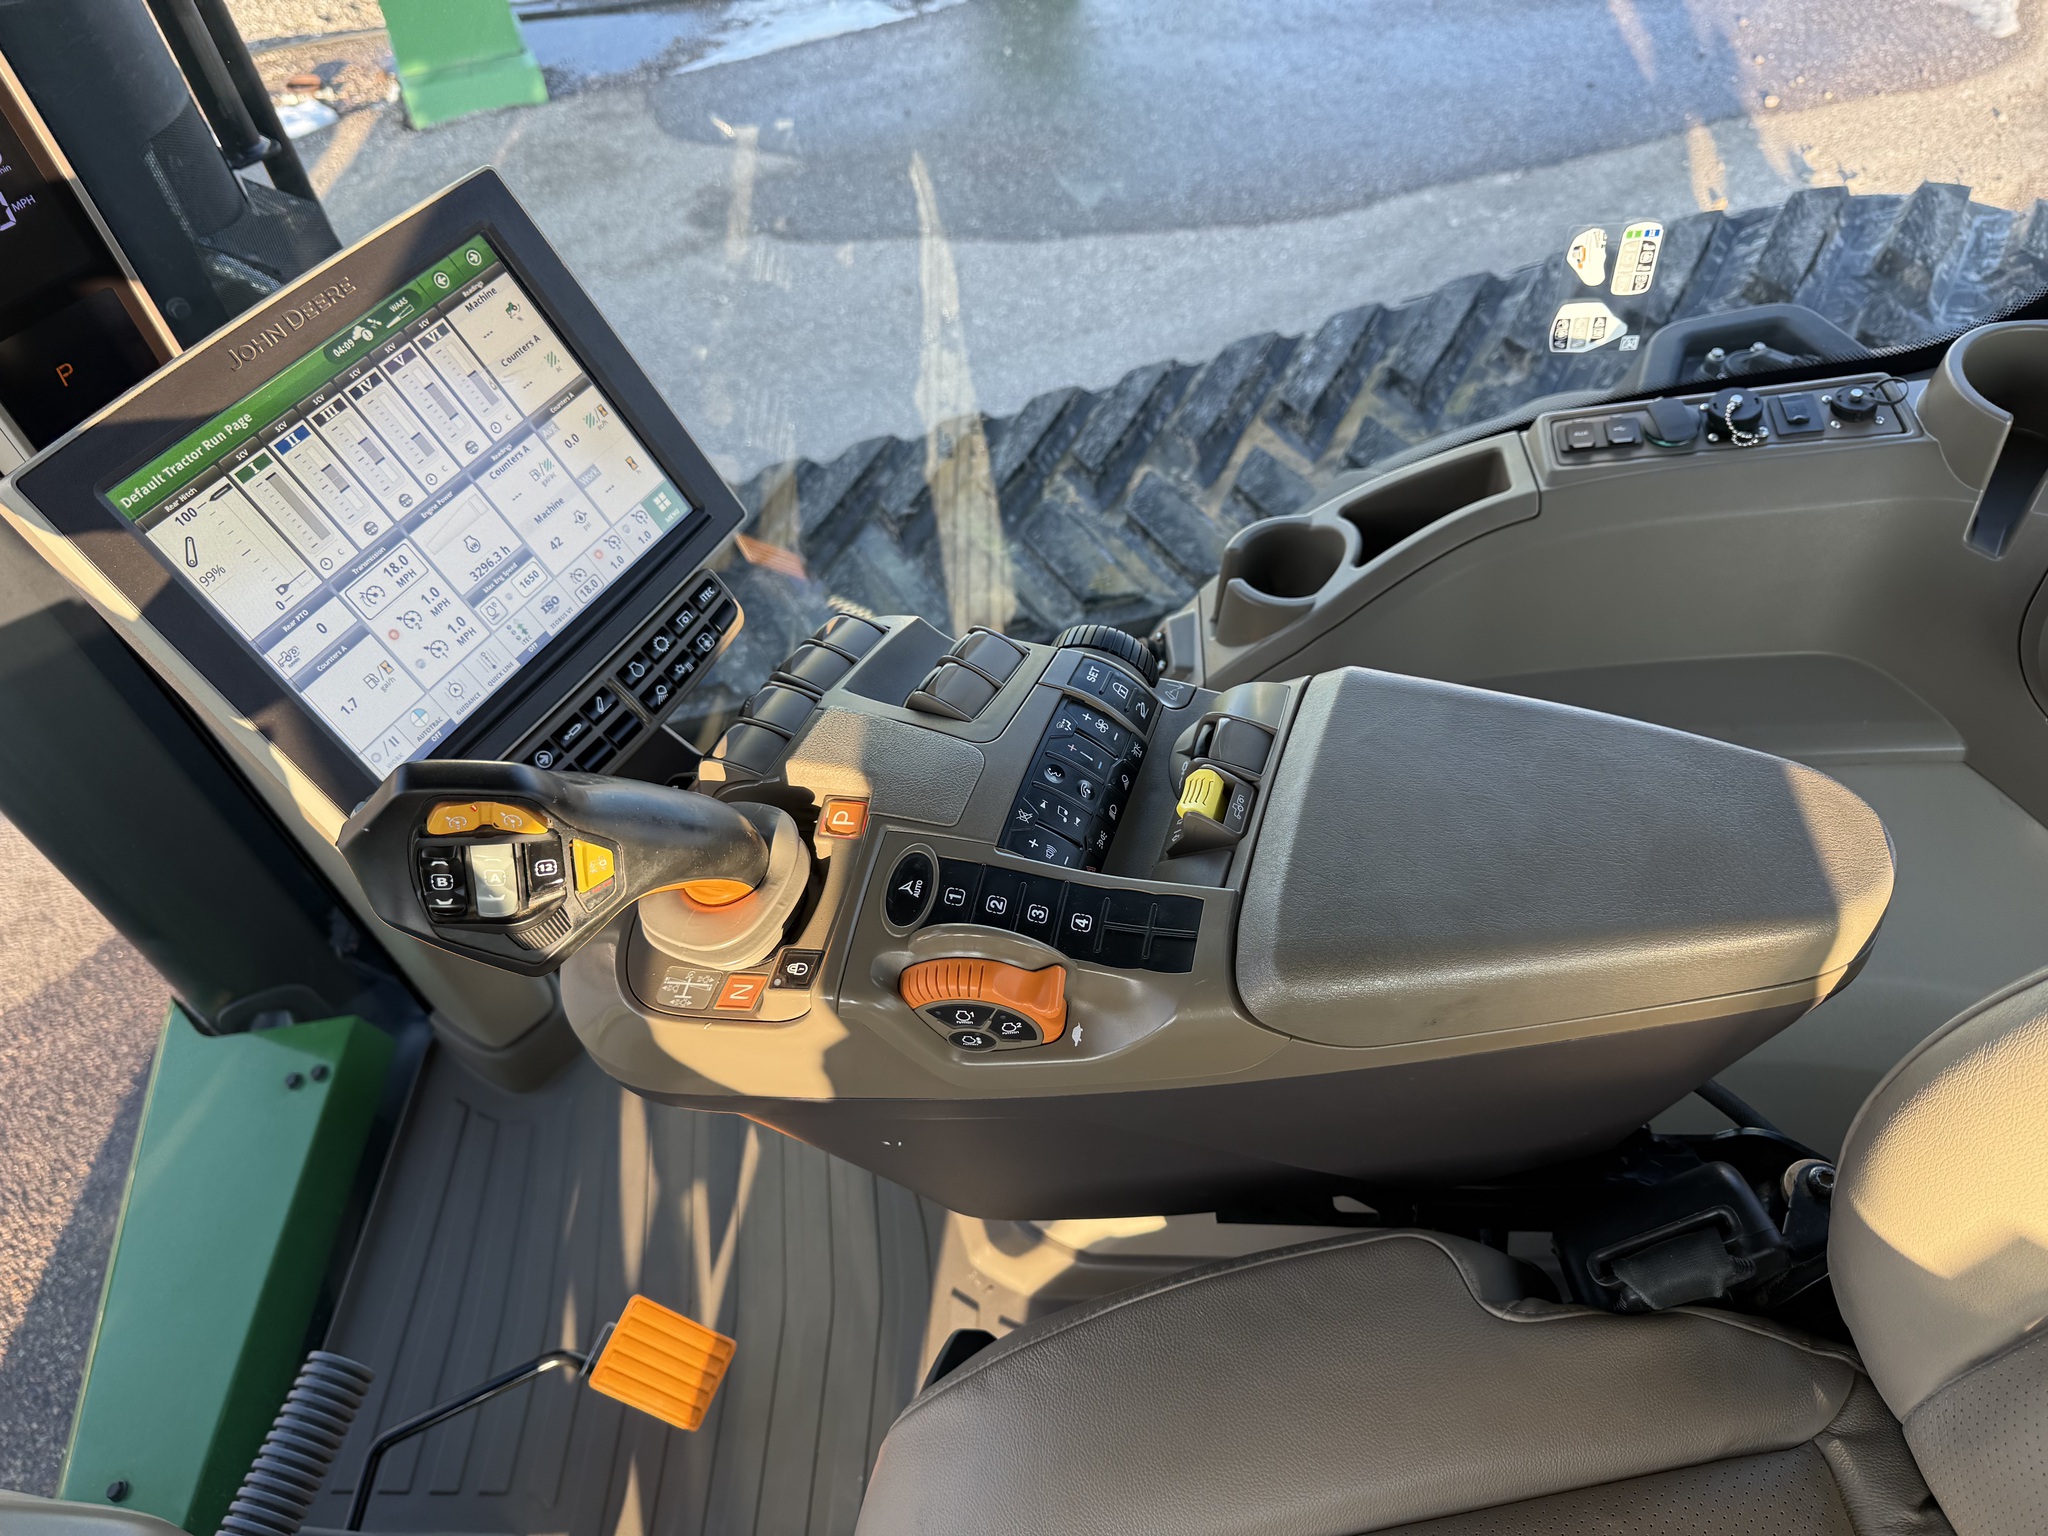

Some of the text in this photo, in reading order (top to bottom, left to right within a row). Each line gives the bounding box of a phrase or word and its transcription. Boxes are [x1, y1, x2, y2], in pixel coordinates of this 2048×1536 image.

[11, 194, 36, 212] MPH
[389, 296, 408, 312] WAAS
[464, 286, 498, 313] Machine
[228, 276, 356, 372] JOHN DEERE
[418, 318, 430, 330] SCV
[426, 328, 443, 343] VI
[332, 338, 355, 358] 04:09
[384, 342, 396, 354] SCV
[500, 334, 542, 368] Counters A
[393, 354, 405, 367] V
[56, 363, 74, 387] P
[349, 368, 362, 380] SCV
[356, 378, 374, 395] IV
[312, 394, 326, 406] SCV
[550, 397, 570, 414] Counters
[320, 403, 340, 422] III
[274, 420, 288, 434] SCV
[284, 432, 301, 448] II
[564, 433, 580, 449] 0.0
[120, 412, 253, 509] Default Tractor Run Page
[236, 448, 249, 461] SCV
[489, 445, 530, 480] Counters A
[248, 462, 260, 474] I
[579, 468, 600, 486] Work
[164, 487, 198, 512] Rear Hitch
[420, 491, 454, 519] Engine Power
[174, 507, 198, 526] 100
[534, 498, 565, 524] Machine
[664, 508, 680, 523] MENU
[550, 536, 564, 550] 42
[638, 530, 652, 544] 1.0
[352, 546, 386, 575] Transmission
[383, 554, 409, 578] 18.0
[469, 545, 511, 582] 3296.3 h
[610, 556, 625, 569] 1.0
[200, 564, 226, 588] 99%
[396, 568, 418, 588] MPH
[482, 562, 518, 594] Max Eng Speed
[519, 570, 540, 589] 1650
[420, 586, 440, 605] 1.0
[580, 580, 599, 598] 18.0
[700, 586, 716, 602] iTEC
[276, 600, 286, 611] 0
[430, 598, 451, 617] MPH
[540, 595, 560, 615] ISO
[282, 609, 309, 632] Rear PTO
[316, 622, 328, 634] 0
[447, 616, 466, 634] 1.0
[456, 626, 477, 647] MPH
[316, 645, 348, 672] Counters A
[488, 662, 515, 687] QUICK LINE
[1086, 665, 1100, 682] SET
[380, 676, 396, 692] gal/h
[340, 697, 358, 714] 1.7
[456, 692, 482, 716] GUIDANCE
[416, 716, 443, 742] AUTOTRAC
[832, 810, 855, 826] P
[538, 863, 554, 873] 12
[436, 876, 448, 888] B
[490, 872, 500, 883] A
[912, 879, 923, 899] AUTO
[948, 892, 962, 902] 1
[990, 899, 1004, 910] 2
[1031, 908, 1045, 919] 3
[1074, 916, 1089, 929] 4
[729, 983, 754, 1000] N
